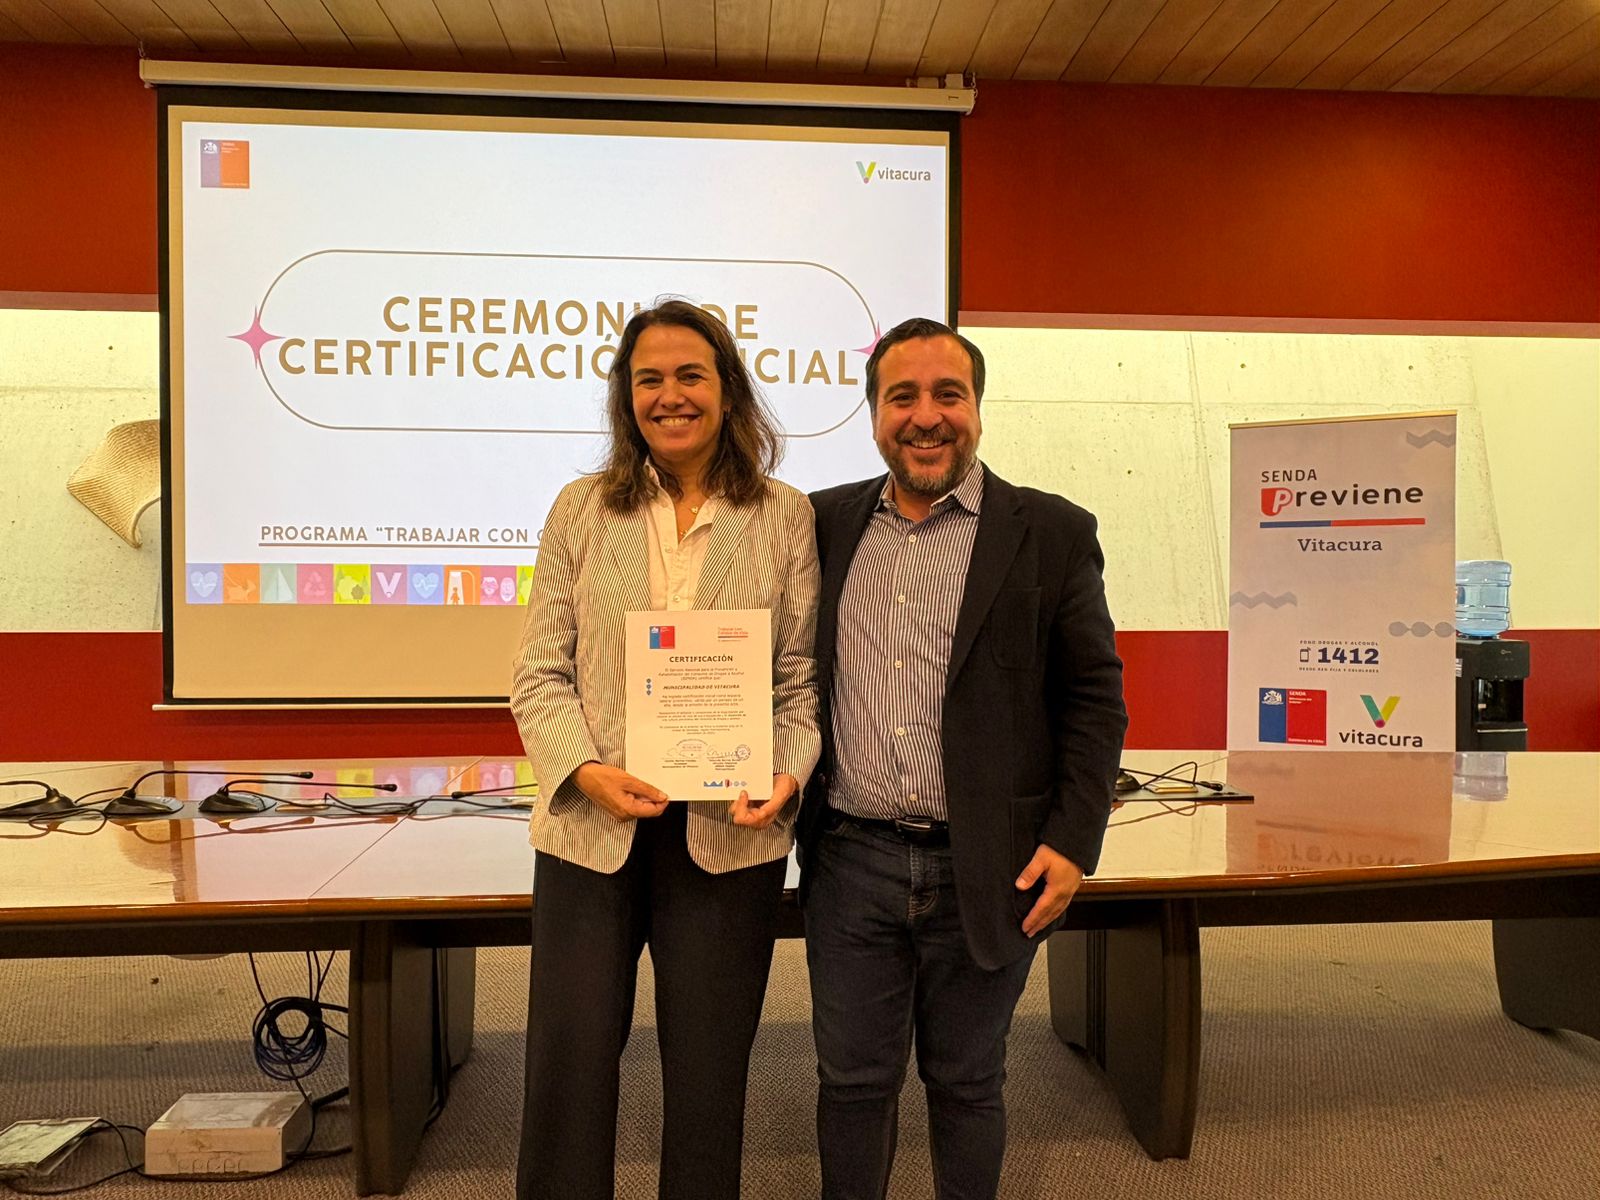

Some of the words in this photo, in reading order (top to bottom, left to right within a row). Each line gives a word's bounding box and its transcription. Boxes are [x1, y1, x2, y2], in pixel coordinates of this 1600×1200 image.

[878, 168, 931, 181] vitacura
[383, 296, 641, 336] CEREMON
[278, 333, 618, 381] CERTIFICACIÓ
[739, 347, 858, 385] CIAL
[1261, 468, 1317, 483] SENDA
[1260, 483, 1424, 516] Previene
[261, 526, 368, 541] PROGRAMA
[488, 528, 528, 543] CON
[1297, 537, 1383, 552] Vitacura
[669, 654, 734, 663] CERTIFICACIÓN
[1317, 647, 1379, 664] 1412
[1338, 730, 1423, 748] vitacura
